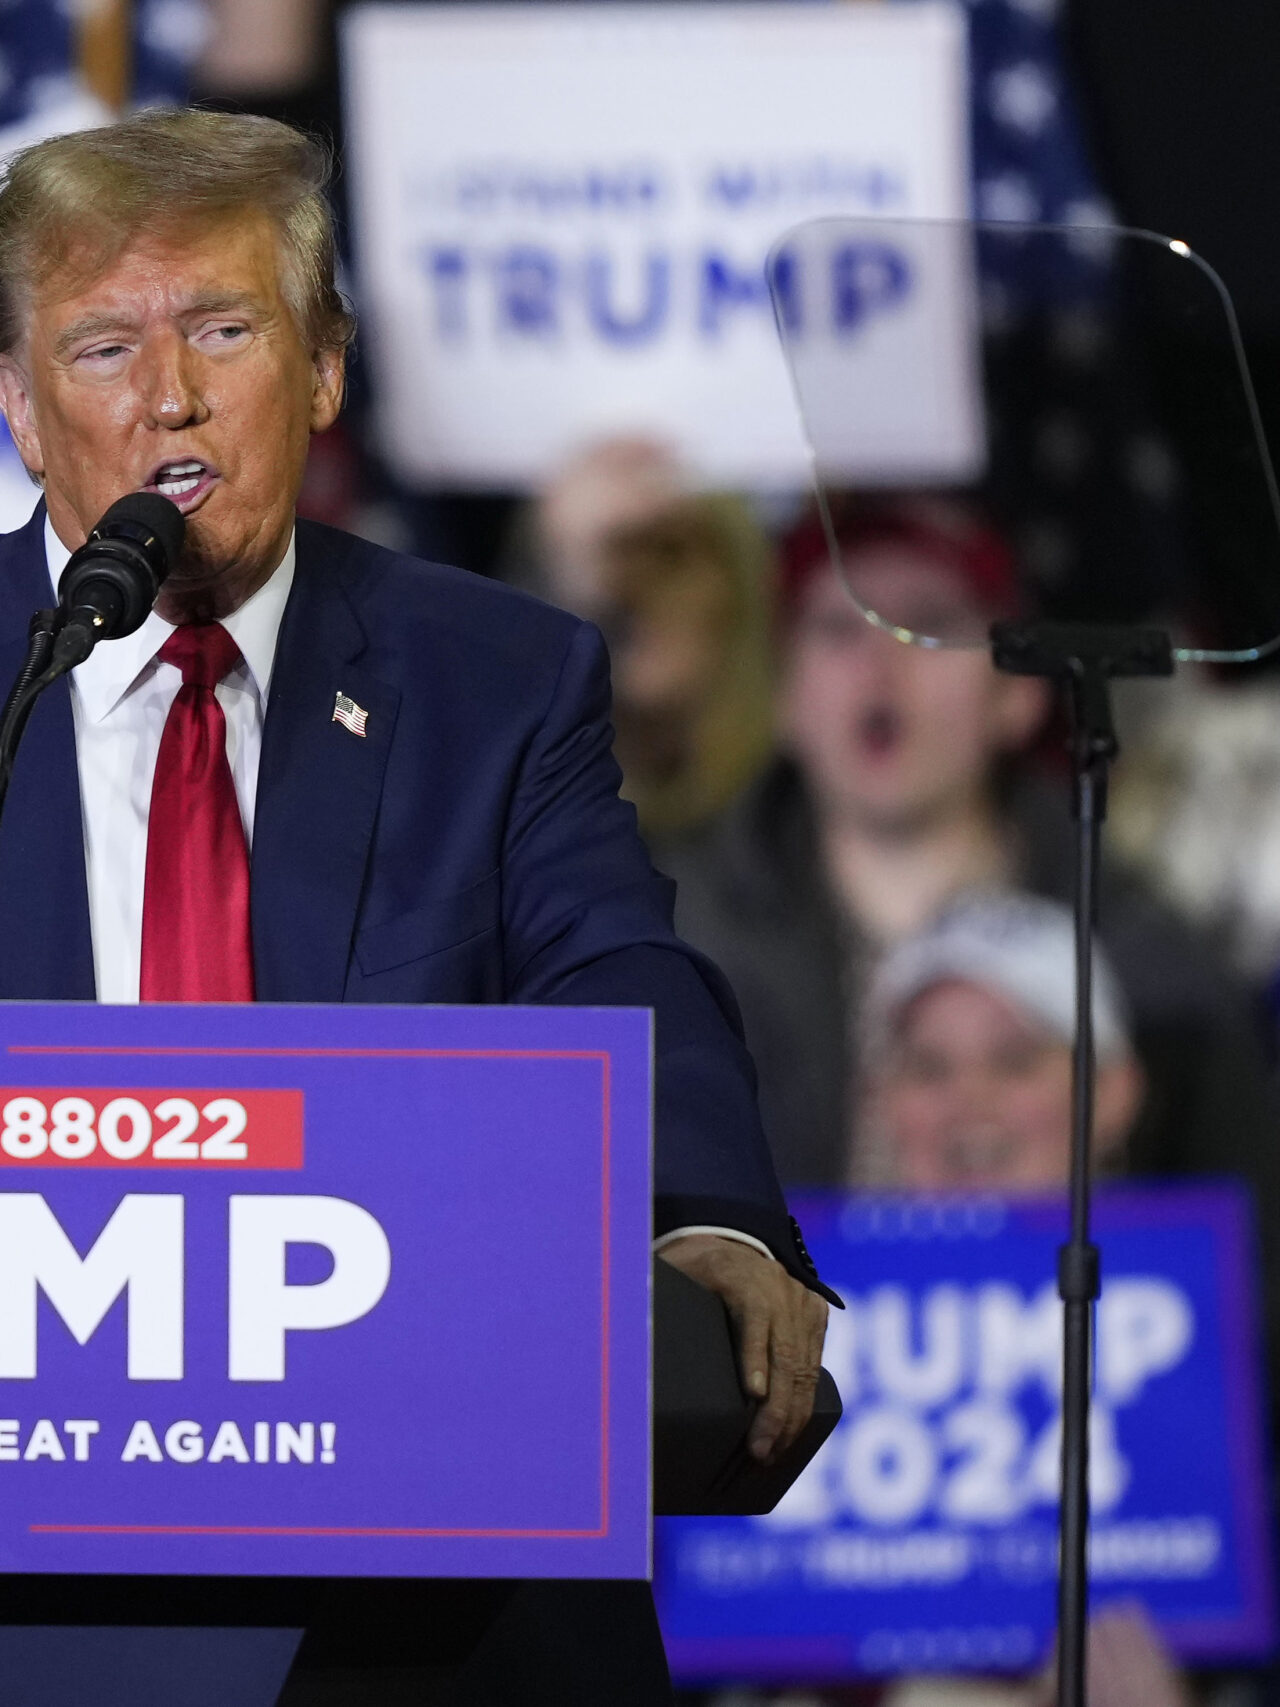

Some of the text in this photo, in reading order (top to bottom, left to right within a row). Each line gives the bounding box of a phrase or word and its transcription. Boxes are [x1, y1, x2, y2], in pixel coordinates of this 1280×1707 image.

[426, 240, 914, 350] TRUMP
[0, 1097, 248, 1160] 88022
[822, 1277, 1196, 1404] UMP
[121, 1420, 336, 1464] AGAIN!
